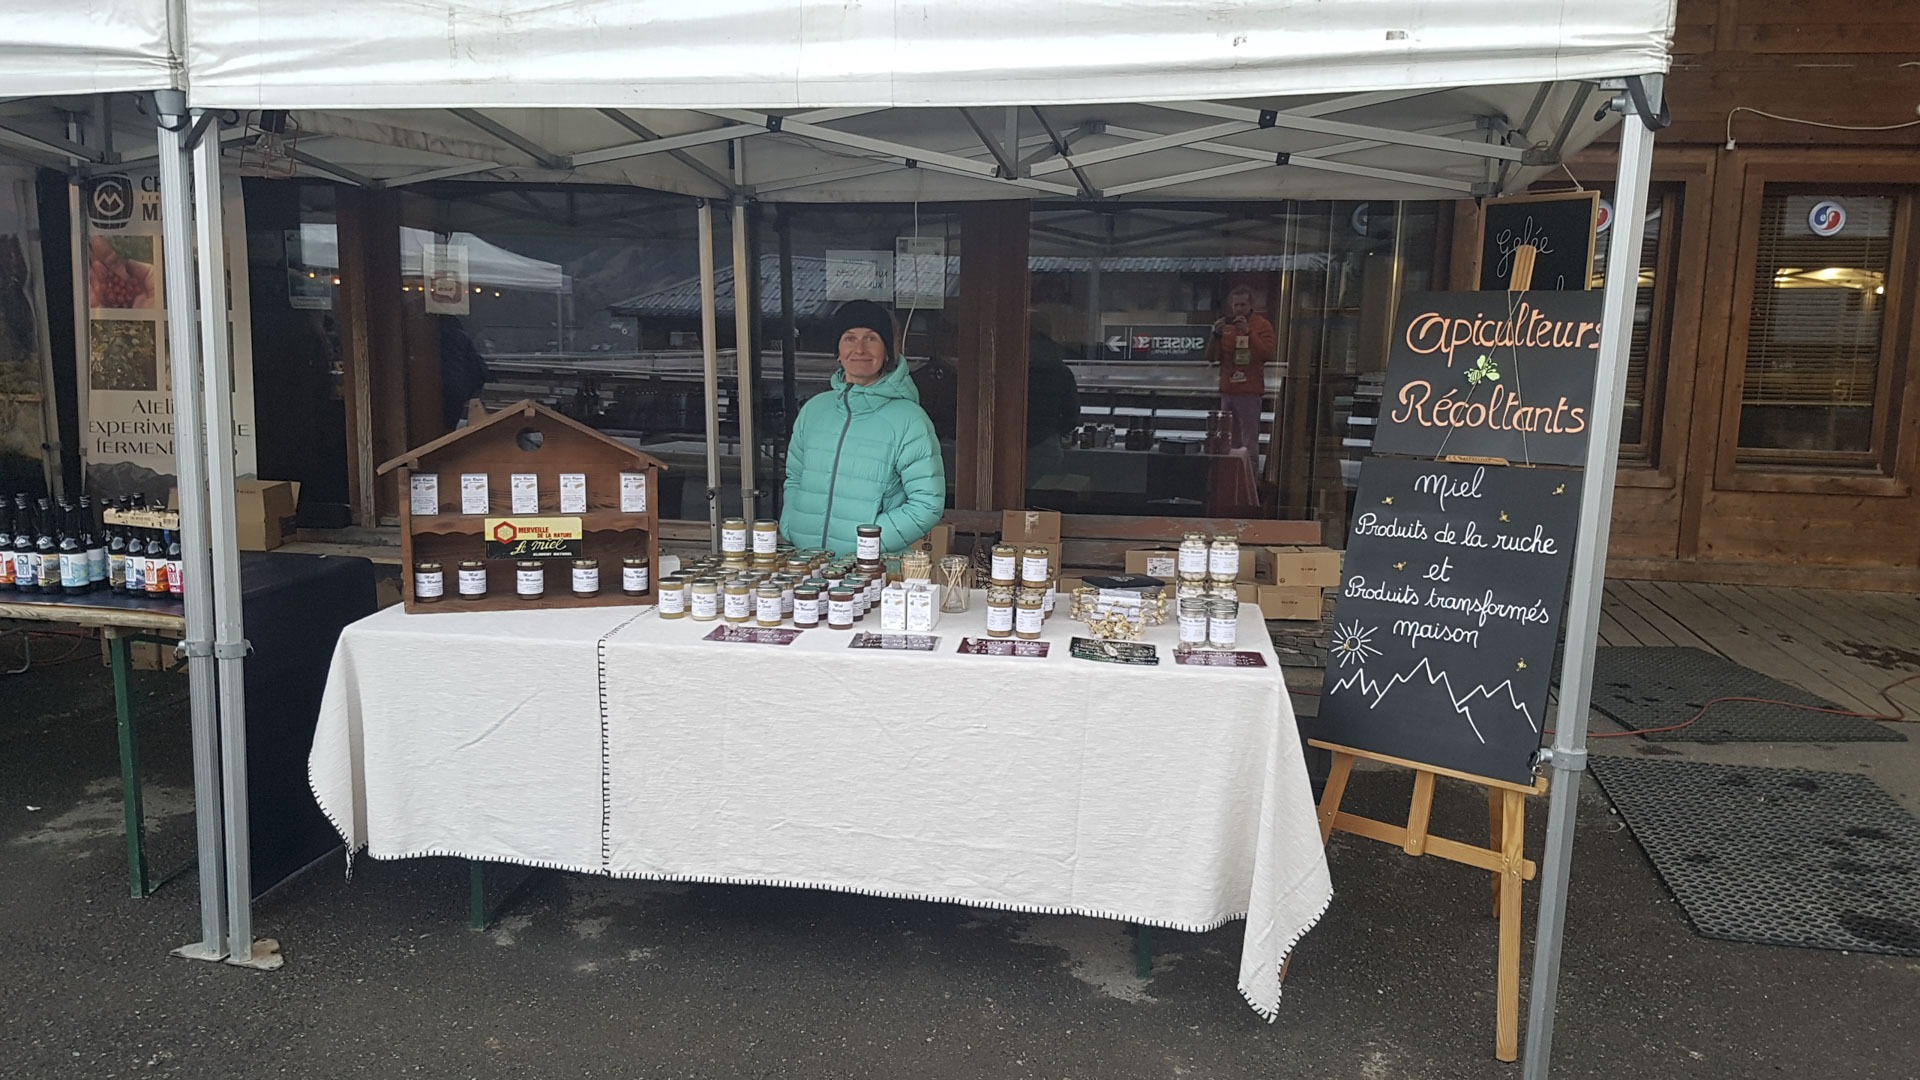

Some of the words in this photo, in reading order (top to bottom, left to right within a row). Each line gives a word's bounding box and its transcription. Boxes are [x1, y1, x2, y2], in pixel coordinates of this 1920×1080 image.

[1406, 302, 1602, 367] Apiculteurs
[1391, 380, 1585, 433] Récoltants
[518, 526, 549, 534] MERVEILLE
[1355, 513, 1428, 541] Produits
[1434, 523, 1456, 545] de
[1460, 521, 1488, 548] la
[1491, 525, 1558, 554] ruche
[1423, 556, 1453, 582] et
[1345, 576, 1419, 606] Produits
[1424, 587, 1549, 627] transformés
